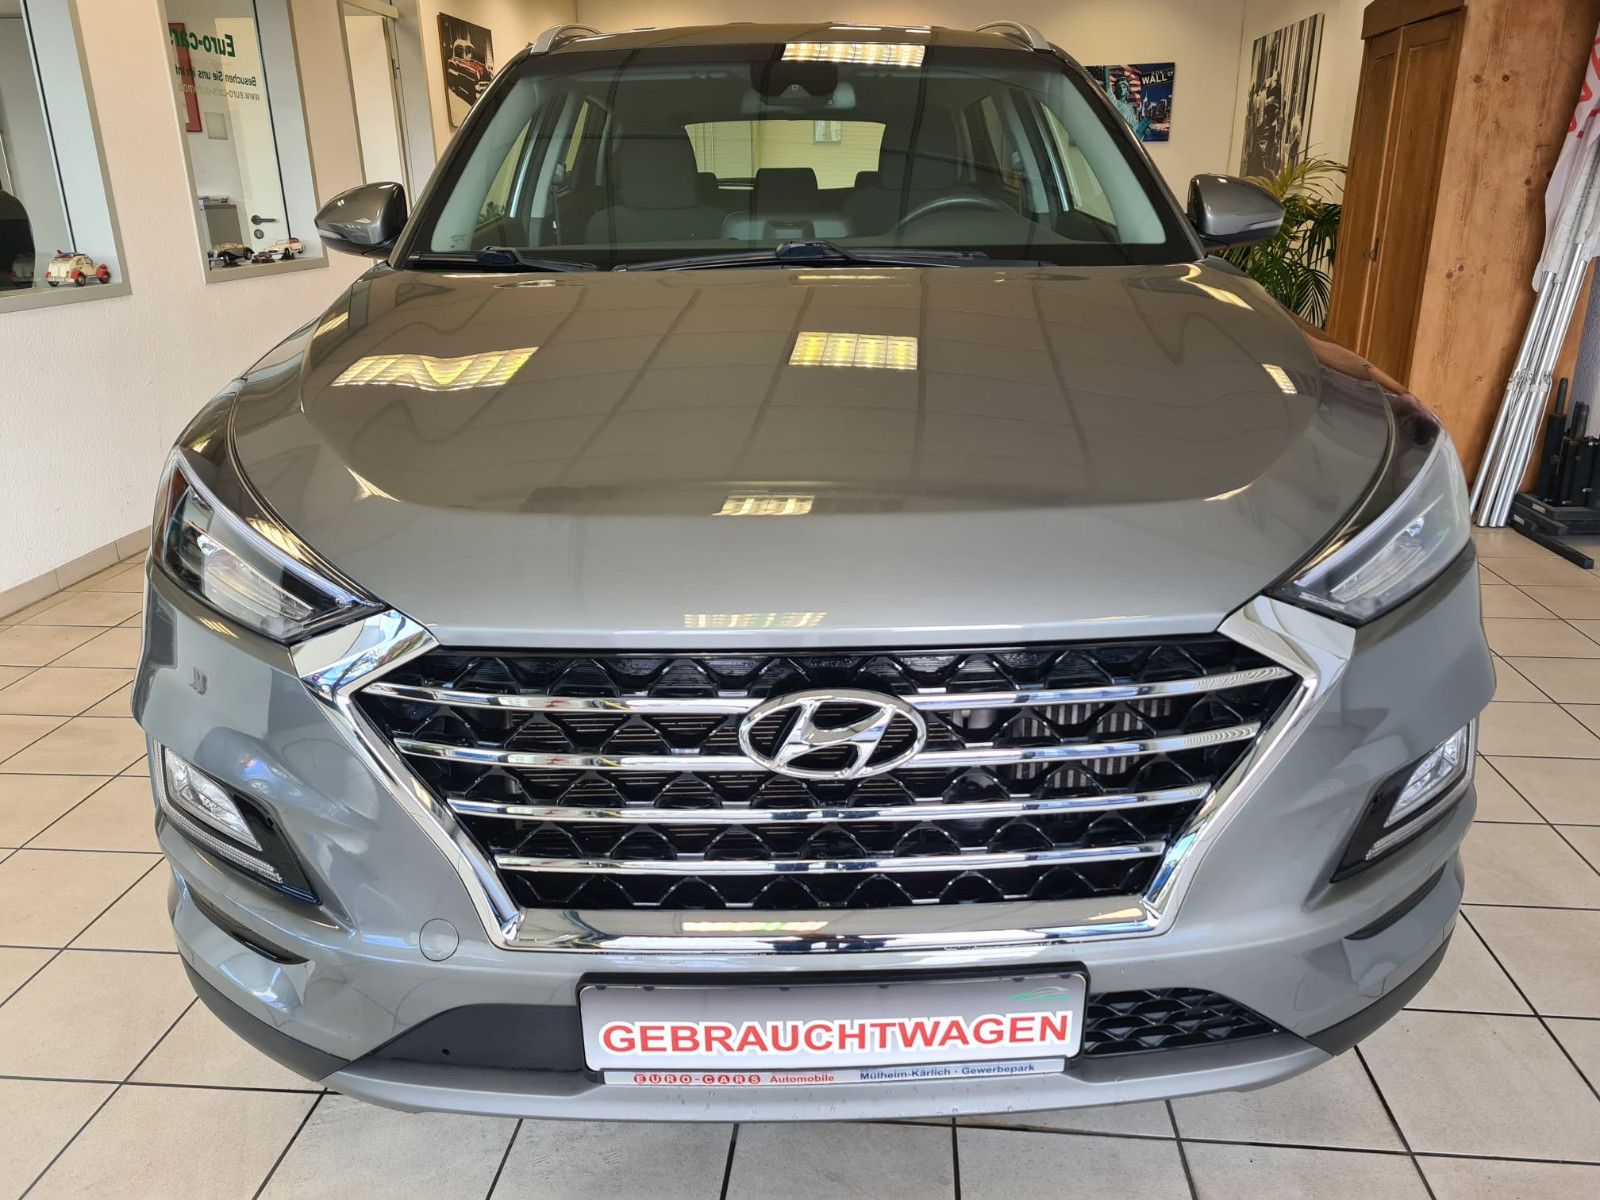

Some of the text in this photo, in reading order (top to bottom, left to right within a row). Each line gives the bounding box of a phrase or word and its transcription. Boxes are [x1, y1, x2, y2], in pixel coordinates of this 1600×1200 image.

[1141, 73, 1168, 85] WALL
[601, 1013, 1070, 1054] GEBRAUCHTWAGEN
[634, 1073, 835, 1084] EURO-CARS Automobile
[859, 1064, 1035, 1081] Mülheim-Kärlich Gewerbepark
